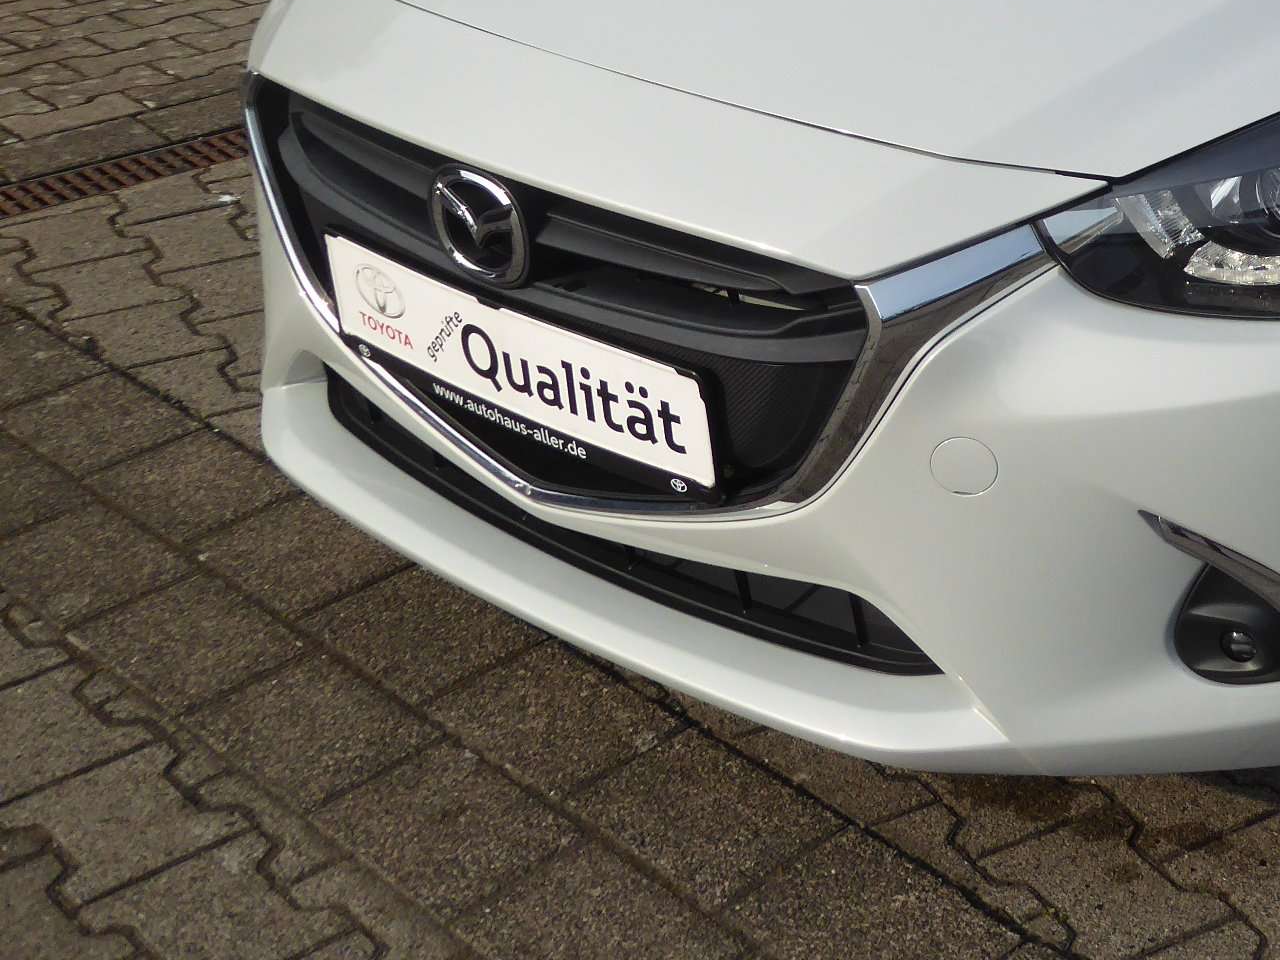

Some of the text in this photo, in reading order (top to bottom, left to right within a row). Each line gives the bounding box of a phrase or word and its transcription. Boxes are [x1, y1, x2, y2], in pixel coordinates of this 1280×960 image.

[360, 311, 414, 350] TOYOTA
[426, 311, 463, 363] geprüfte
[432, 381, 588, 460] www.autohaus-aller.de
[461, 323, 688, 455] Qualität
